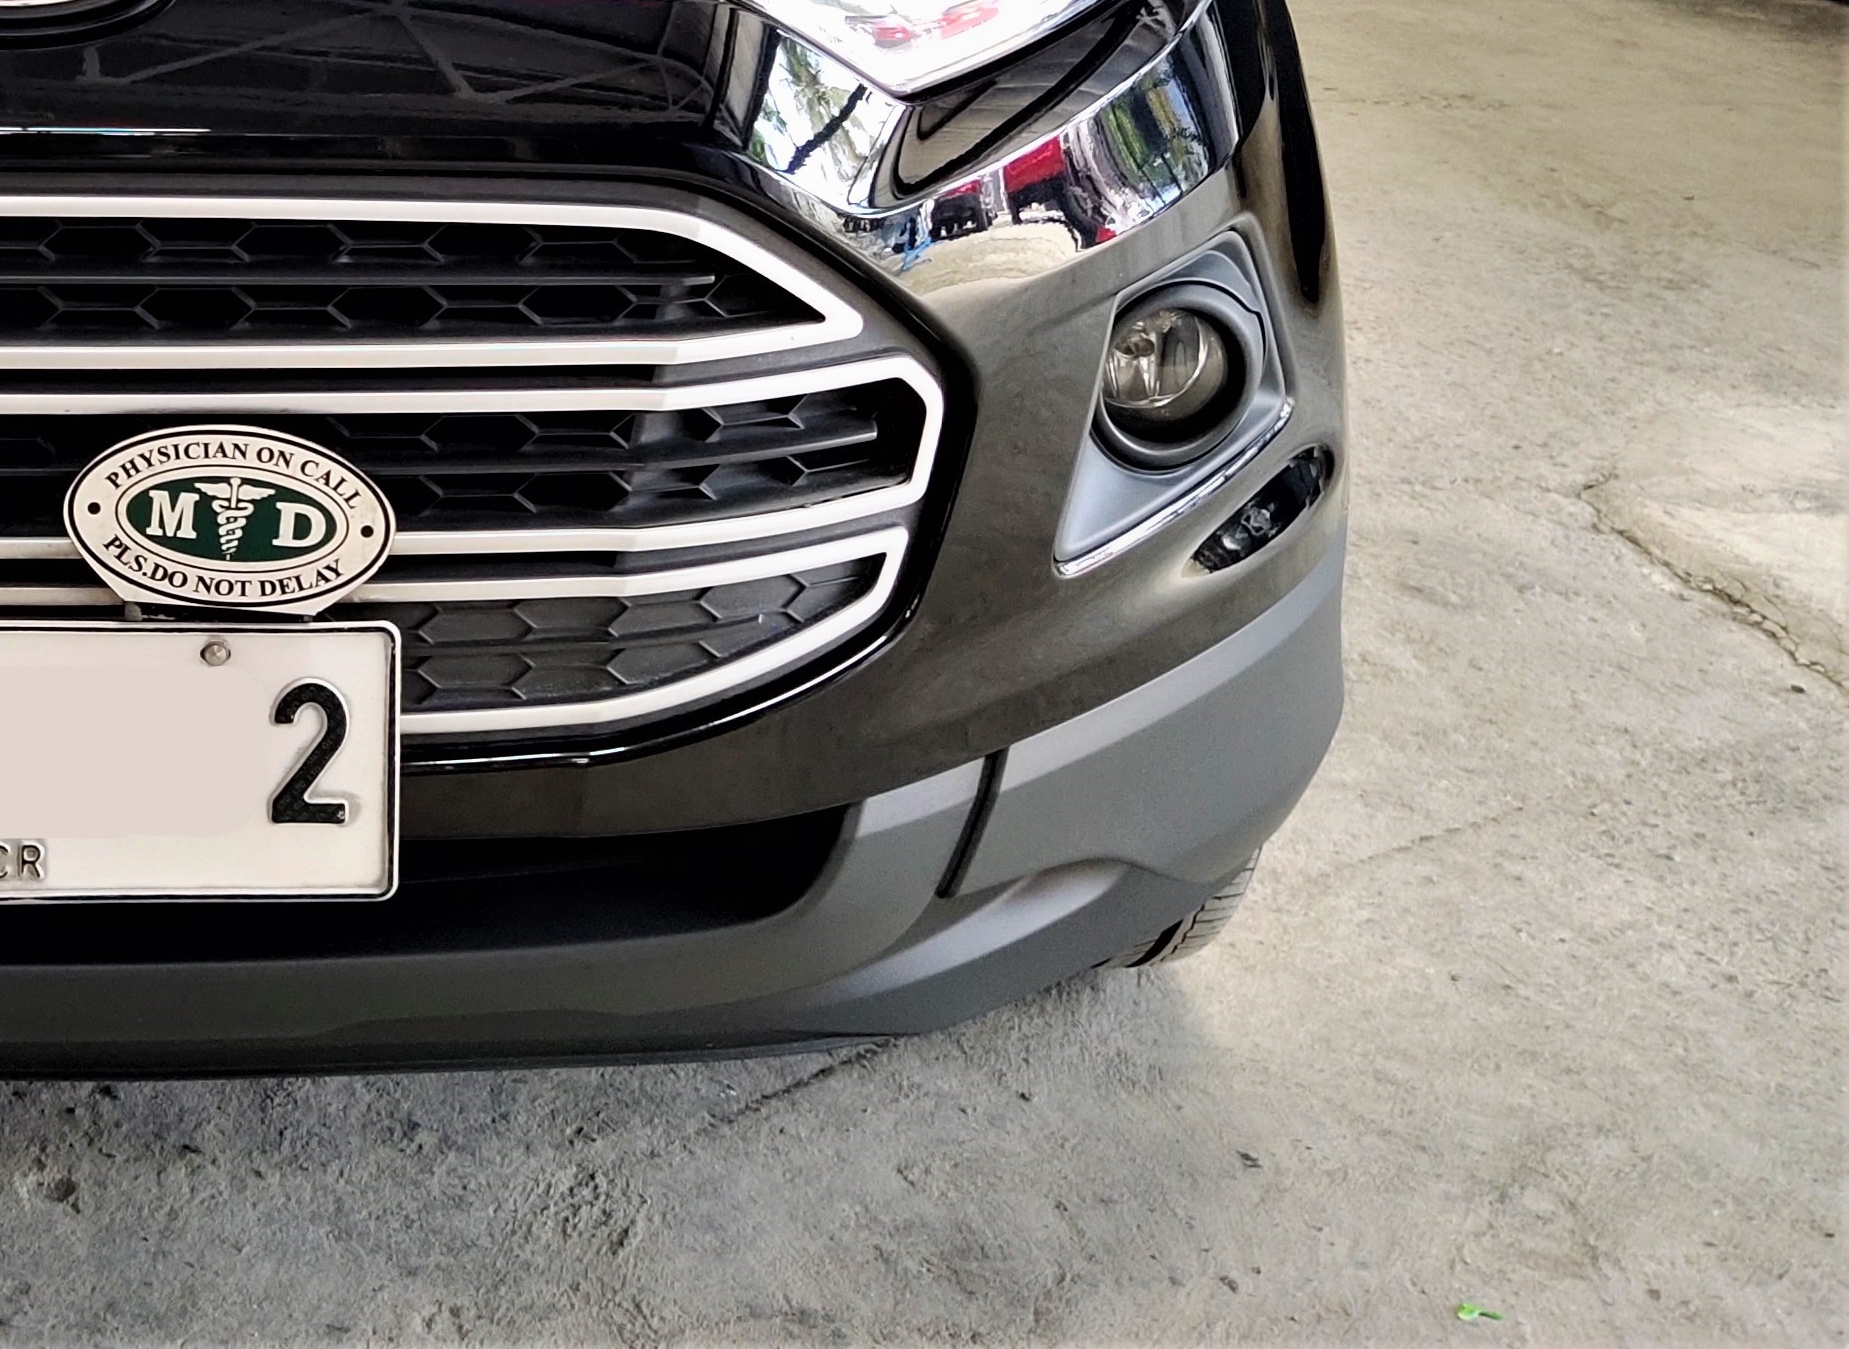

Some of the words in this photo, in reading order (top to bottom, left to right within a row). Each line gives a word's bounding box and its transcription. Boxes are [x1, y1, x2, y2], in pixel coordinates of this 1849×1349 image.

[105, 441, 250, 490] PHYSICIAN
[256, 446, 296, 470] ON
[300, 459, 363, 511] CALL
[146, 489, 200, 539] M
[272, 502, 327, 547] D
[195, 575, 252, 598] NOT
[259, 558, 345, 598] DELAY
[269, 679, 349, 824] 2
